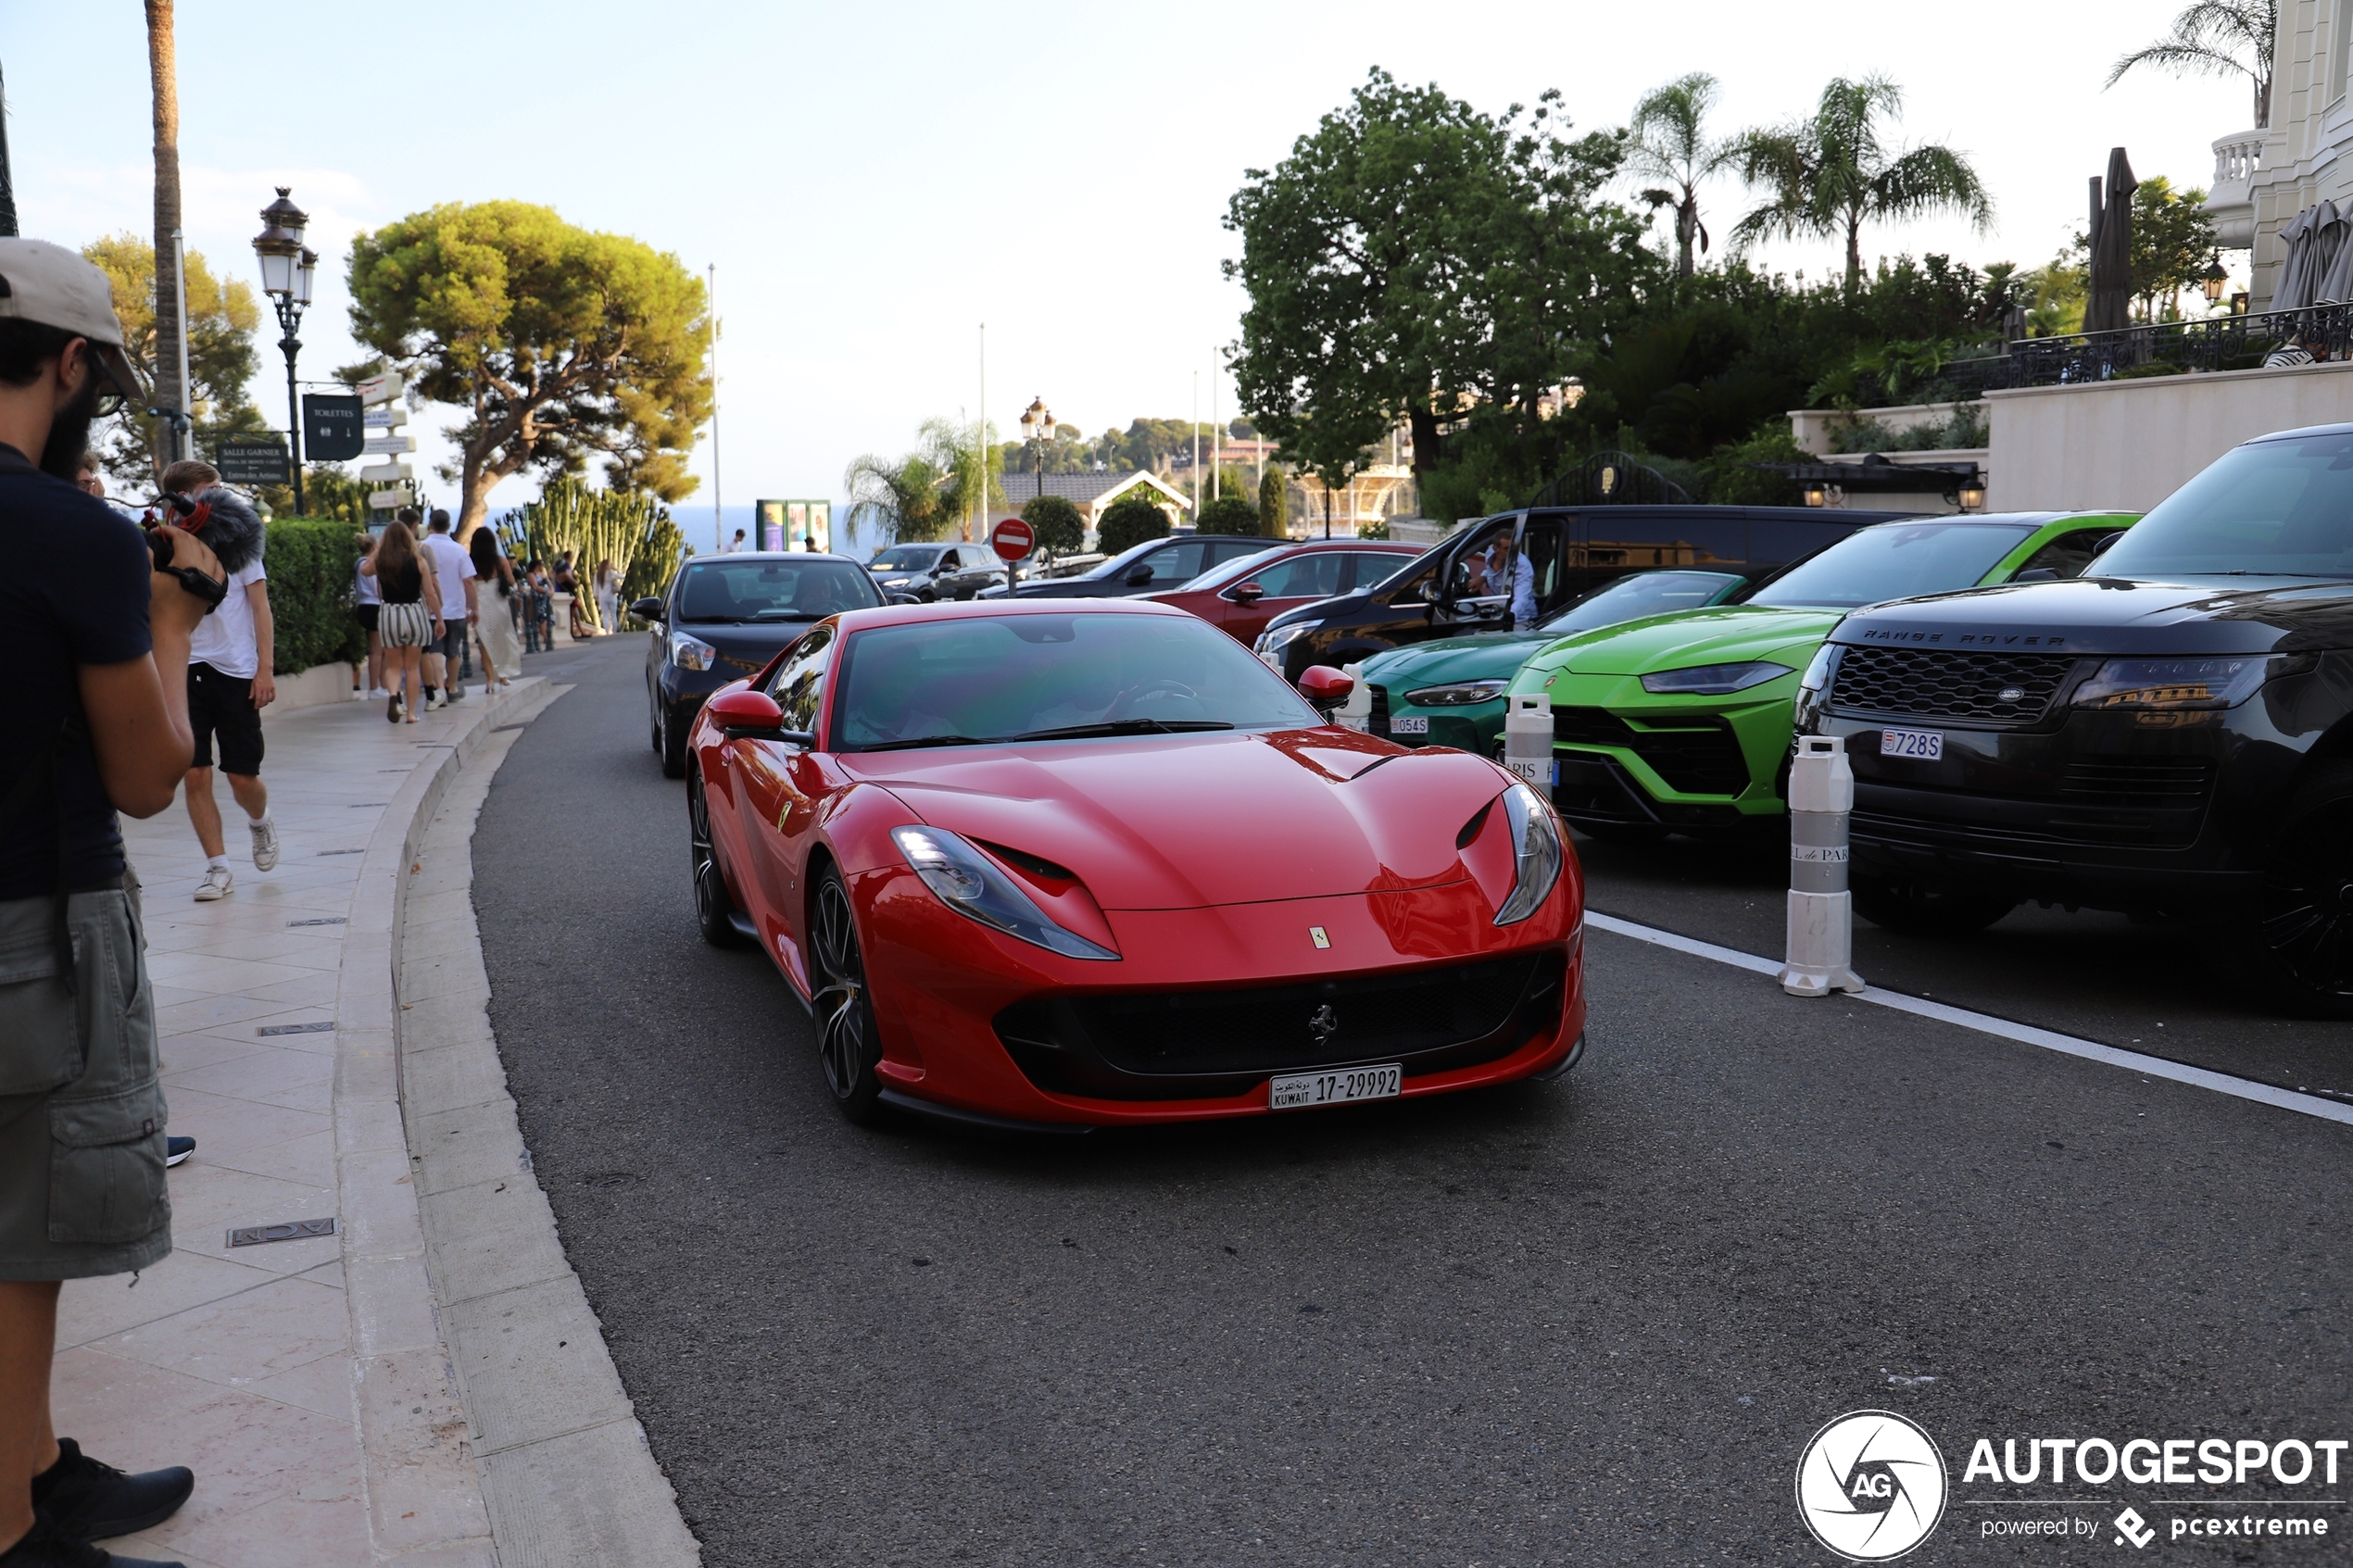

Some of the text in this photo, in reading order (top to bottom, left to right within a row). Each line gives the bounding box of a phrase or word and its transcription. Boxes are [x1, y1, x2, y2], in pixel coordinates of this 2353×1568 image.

[313, 408, 354, 418] TOILETTES
[222, 448, 281, 457] SALLE GARNIER
[1863, 628, 2065, 646] RANGE ROVER
[1399, 719, 1426, 732] 054S
[1895, 733, 1939, 757] 728S
[1805, 849, 1817, 859] de
[1316, 1069, 1397, 1101] 17-29992
[1275, 1091, 1310, 1106] KUWAIT
[234, 1219, 330, 1243] ACM
